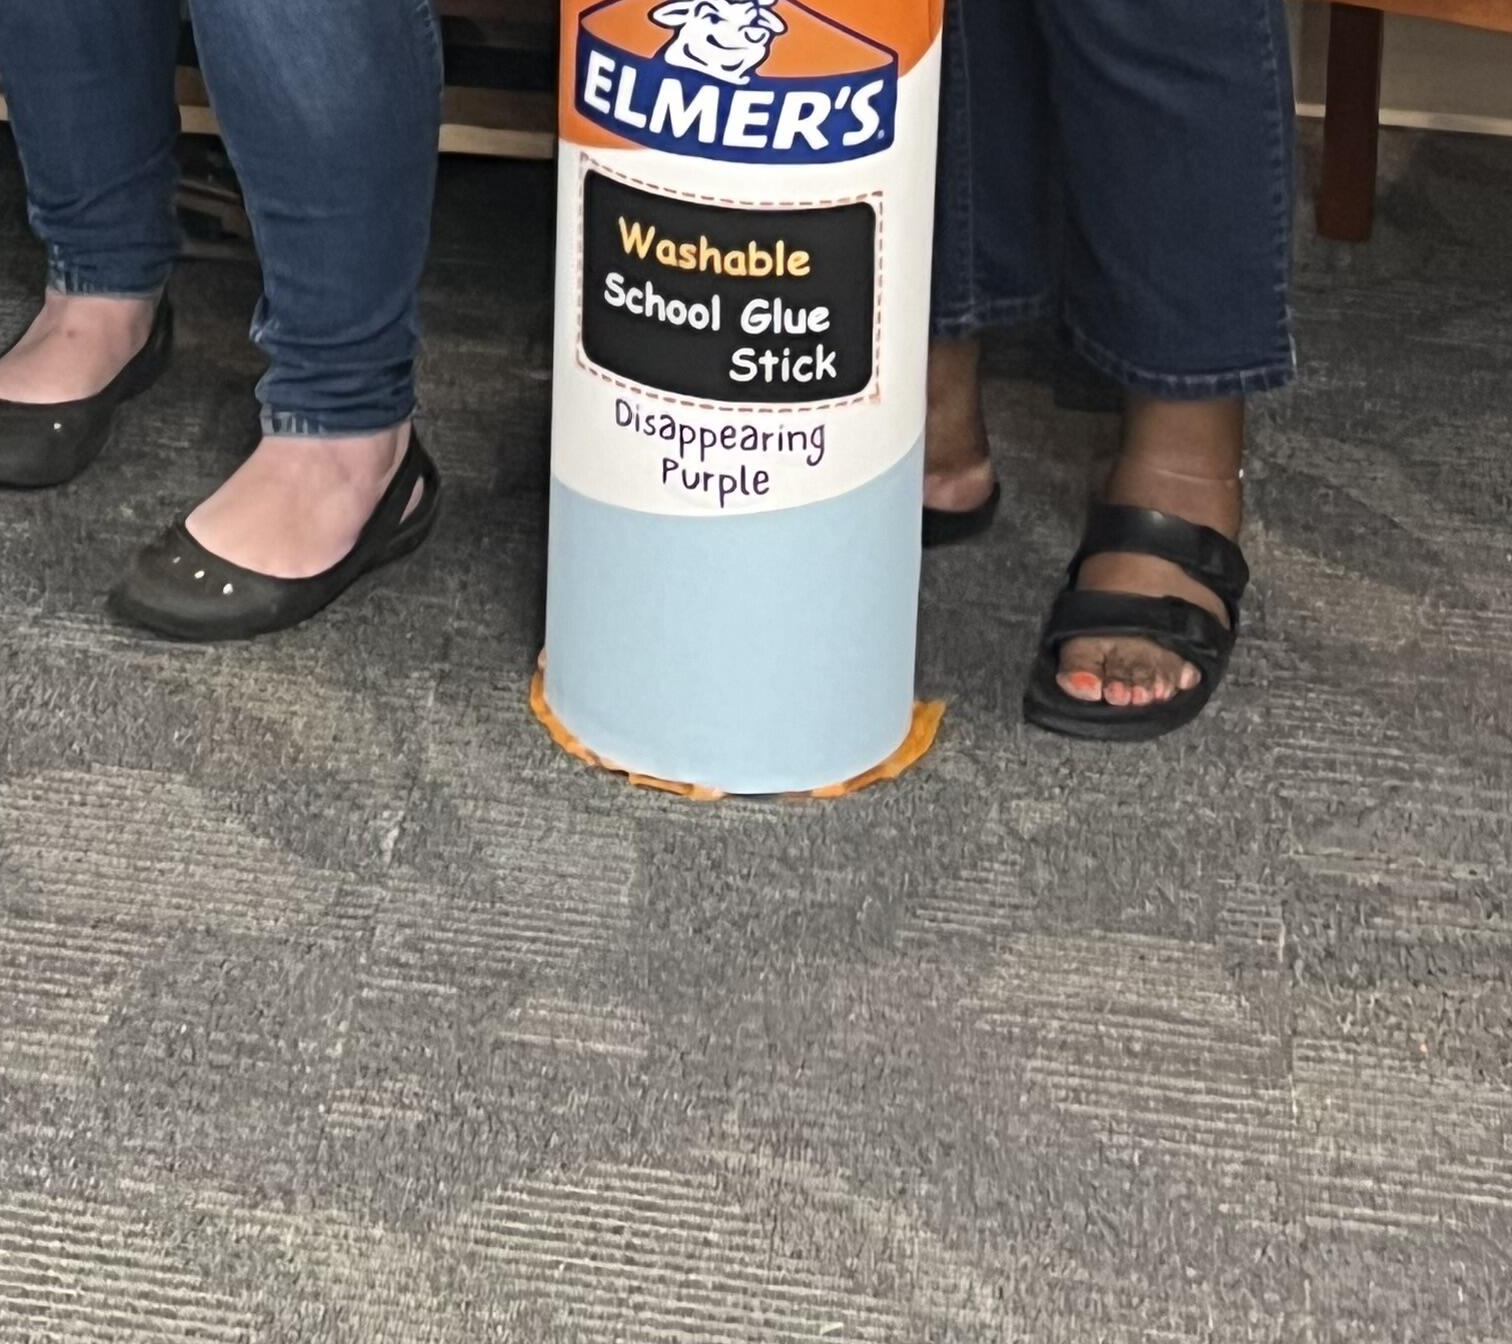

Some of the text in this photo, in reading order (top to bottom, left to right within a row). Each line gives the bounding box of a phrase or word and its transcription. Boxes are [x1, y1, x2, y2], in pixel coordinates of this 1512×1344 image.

[583, 49, 885, 152] ELMER'S
[618, 216, 812, 278] Washable
[603, 272, 832, 337] School Glue
[728, 344, 838, 384] Stick
[614, 399, 827, 467] Disappearing
[661, 457, 771, 508] Purple
